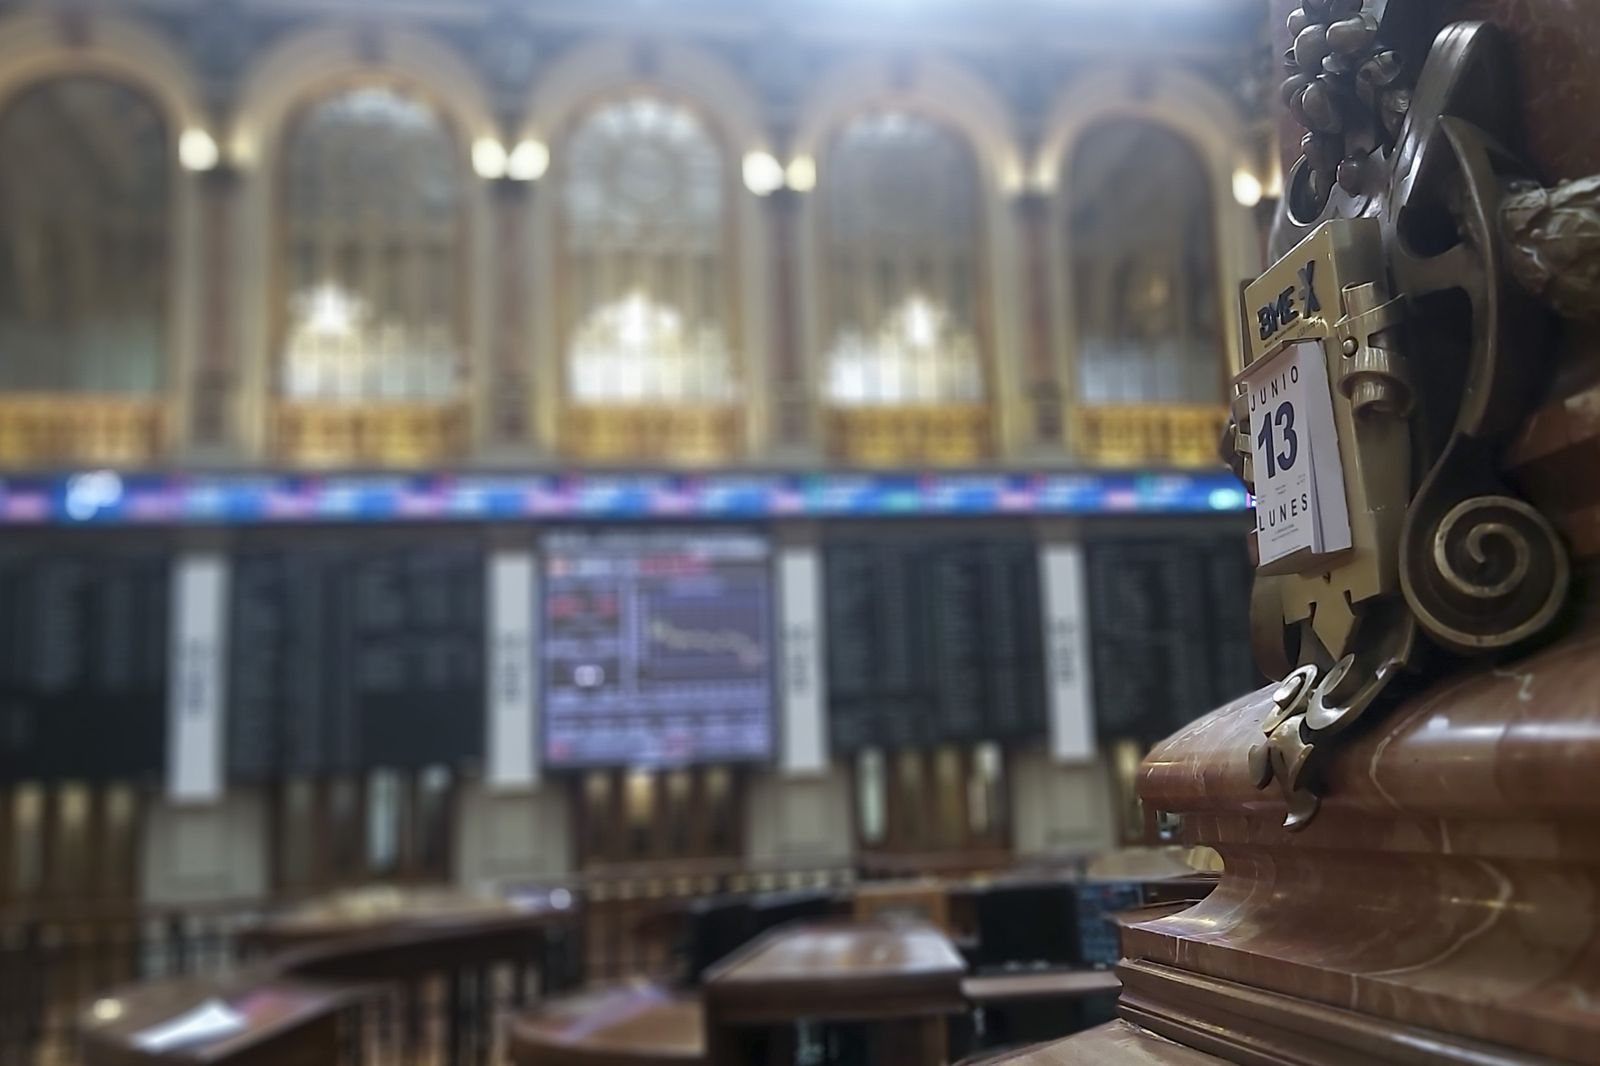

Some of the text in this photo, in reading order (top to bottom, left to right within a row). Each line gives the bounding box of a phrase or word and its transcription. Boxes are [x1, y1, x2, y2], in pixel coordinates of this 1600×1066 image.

[1251, 365, 1298, 412] JUNIO
[1257, 401, 1298, 479] 13
[1258, 493, 1308, 532] LUNES
